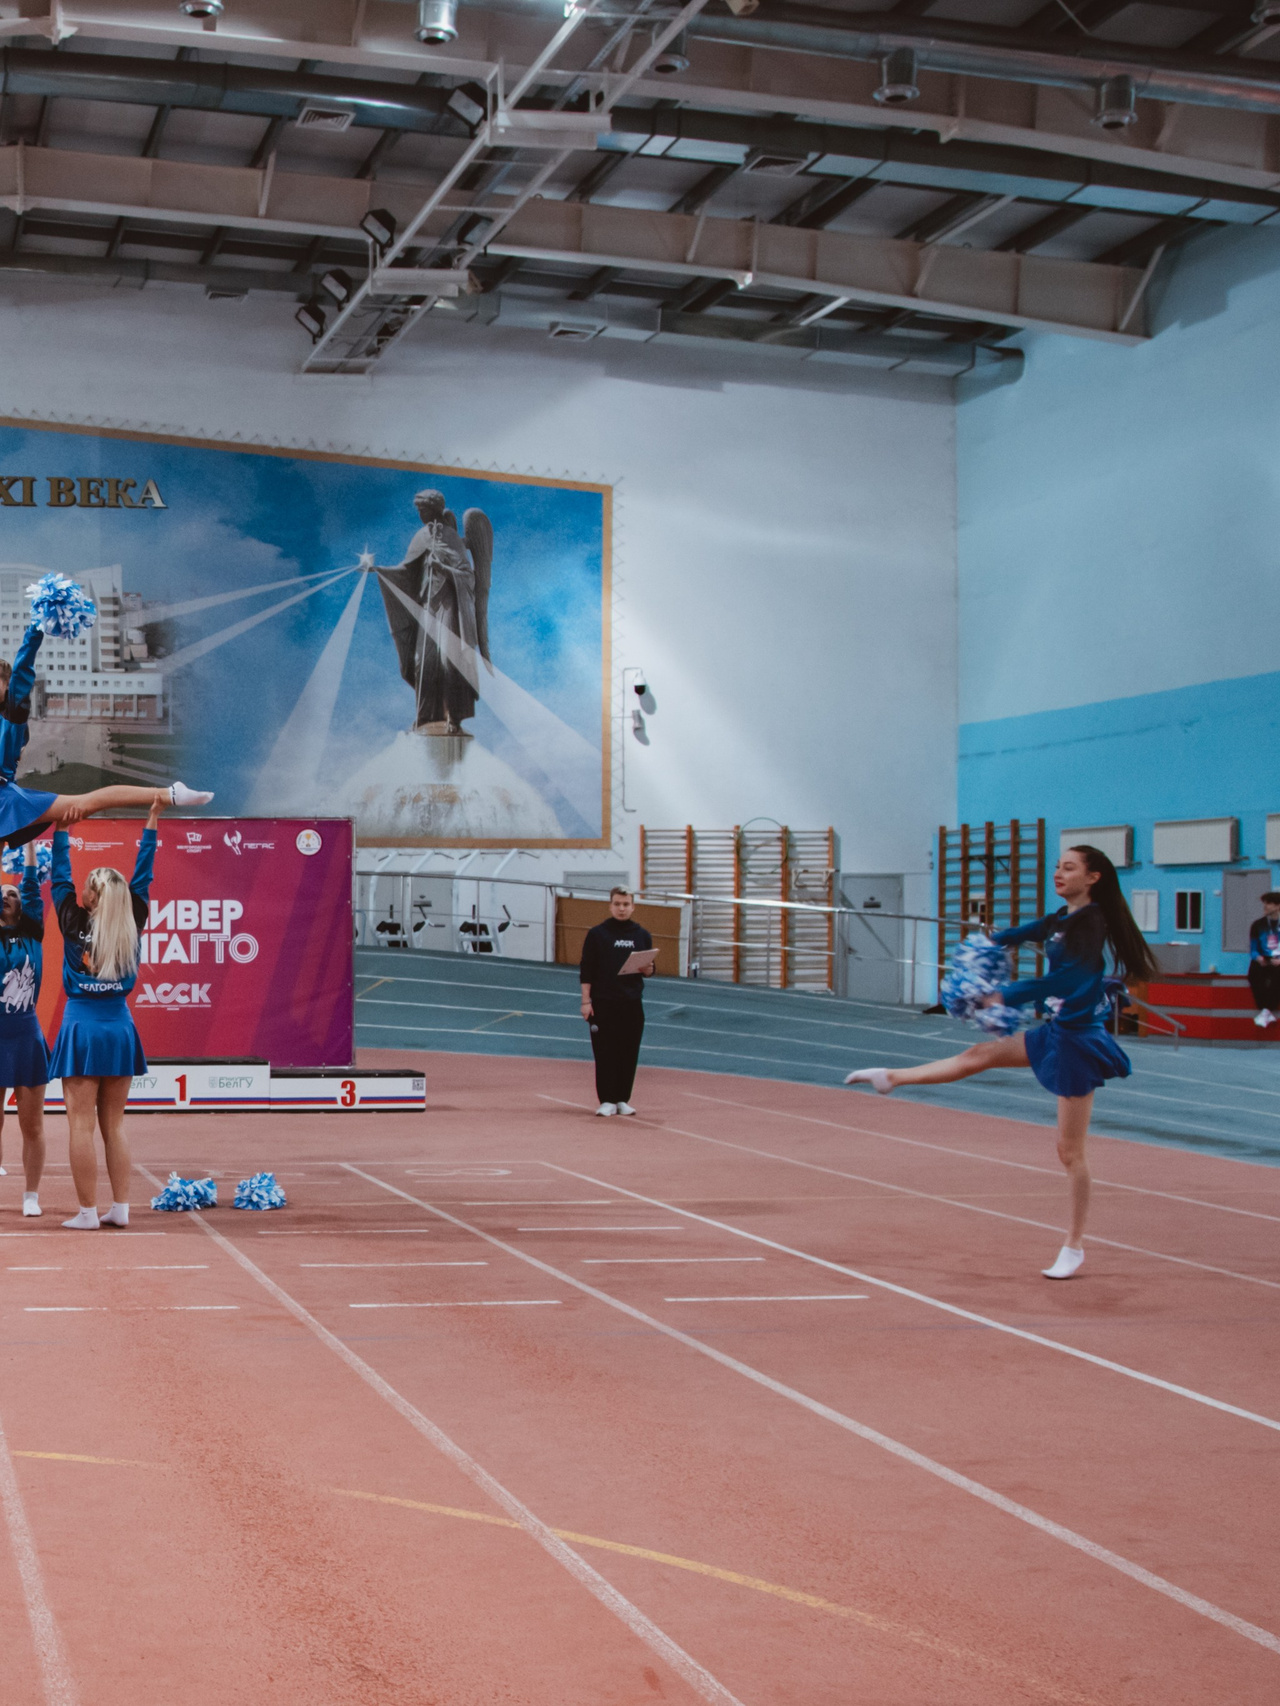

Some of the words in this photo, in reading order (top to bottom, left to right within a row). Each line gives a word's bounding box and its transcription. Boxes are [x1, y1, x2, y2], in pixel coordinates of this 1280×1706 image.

[46, 477, 167, 509] ВЕКА
[243, 842, 275, 850] ПЕГАС
[143, 900, 243, 937] ИВЕР
[175, 1074, 187, 1102] 1
[341, 1080, 356, 1107] 3
